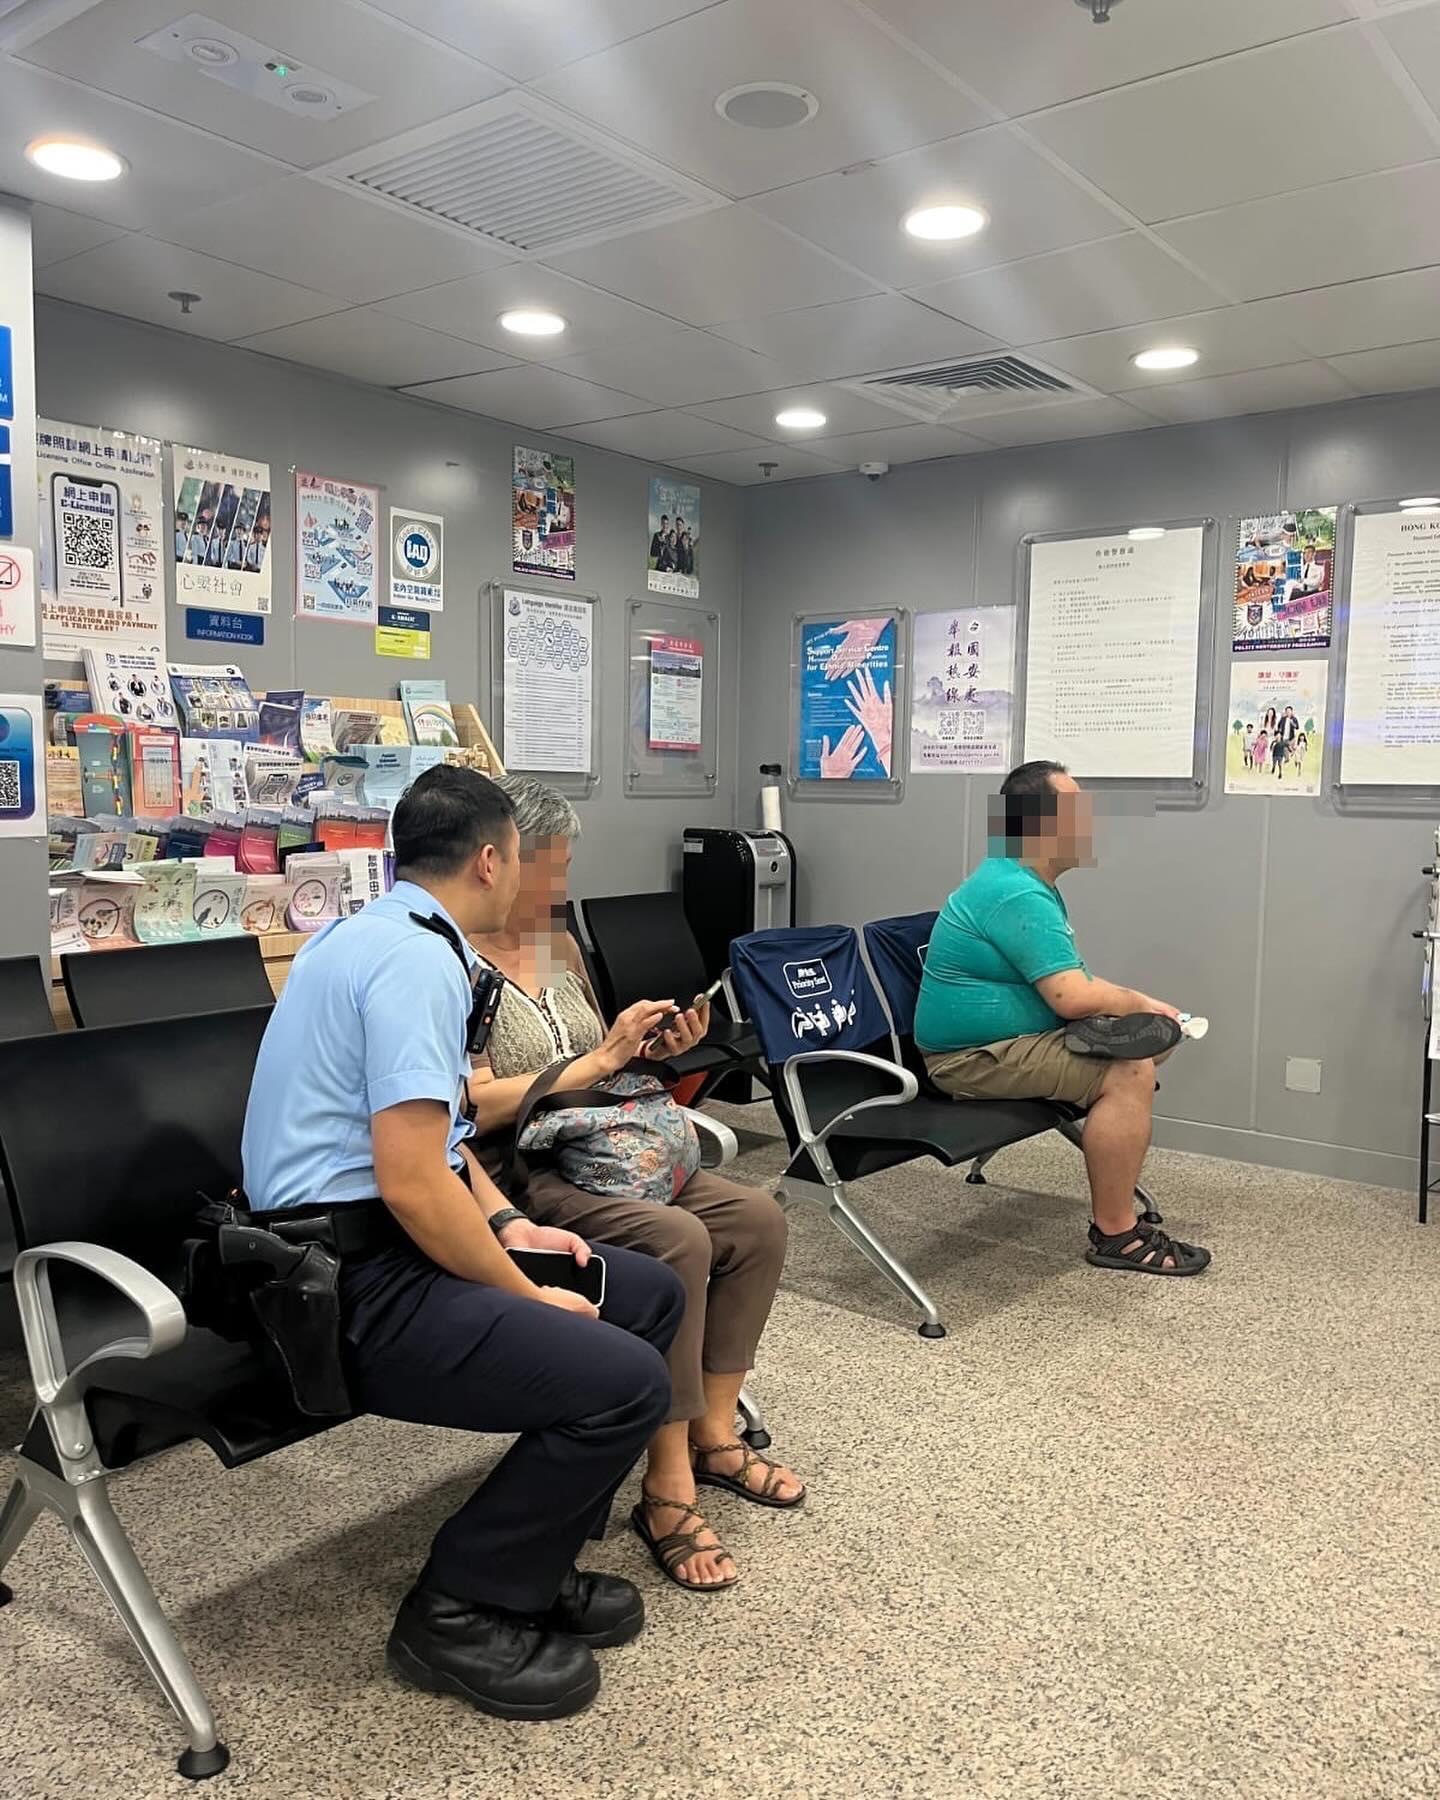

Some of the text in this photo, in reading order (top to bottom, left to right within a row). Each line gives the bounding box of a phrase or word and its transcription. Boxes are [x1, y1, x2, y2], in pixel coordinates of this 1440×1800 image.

[71, 456, 92, 467] Office
[95, 461, 116, 471] Online
[1401, 522, 1426, 532] HONG
[50, 614, 102, 625] APPLICATION
[104, 619, 119, 627] AND
[121, 620, 158, 630] PAYMENT
[72, 622, 92, 630] THAT
[806, 646, 834, 657] Support
[864, 643, 889, 653] Centre
[791, 979, 815, 989] Priority
